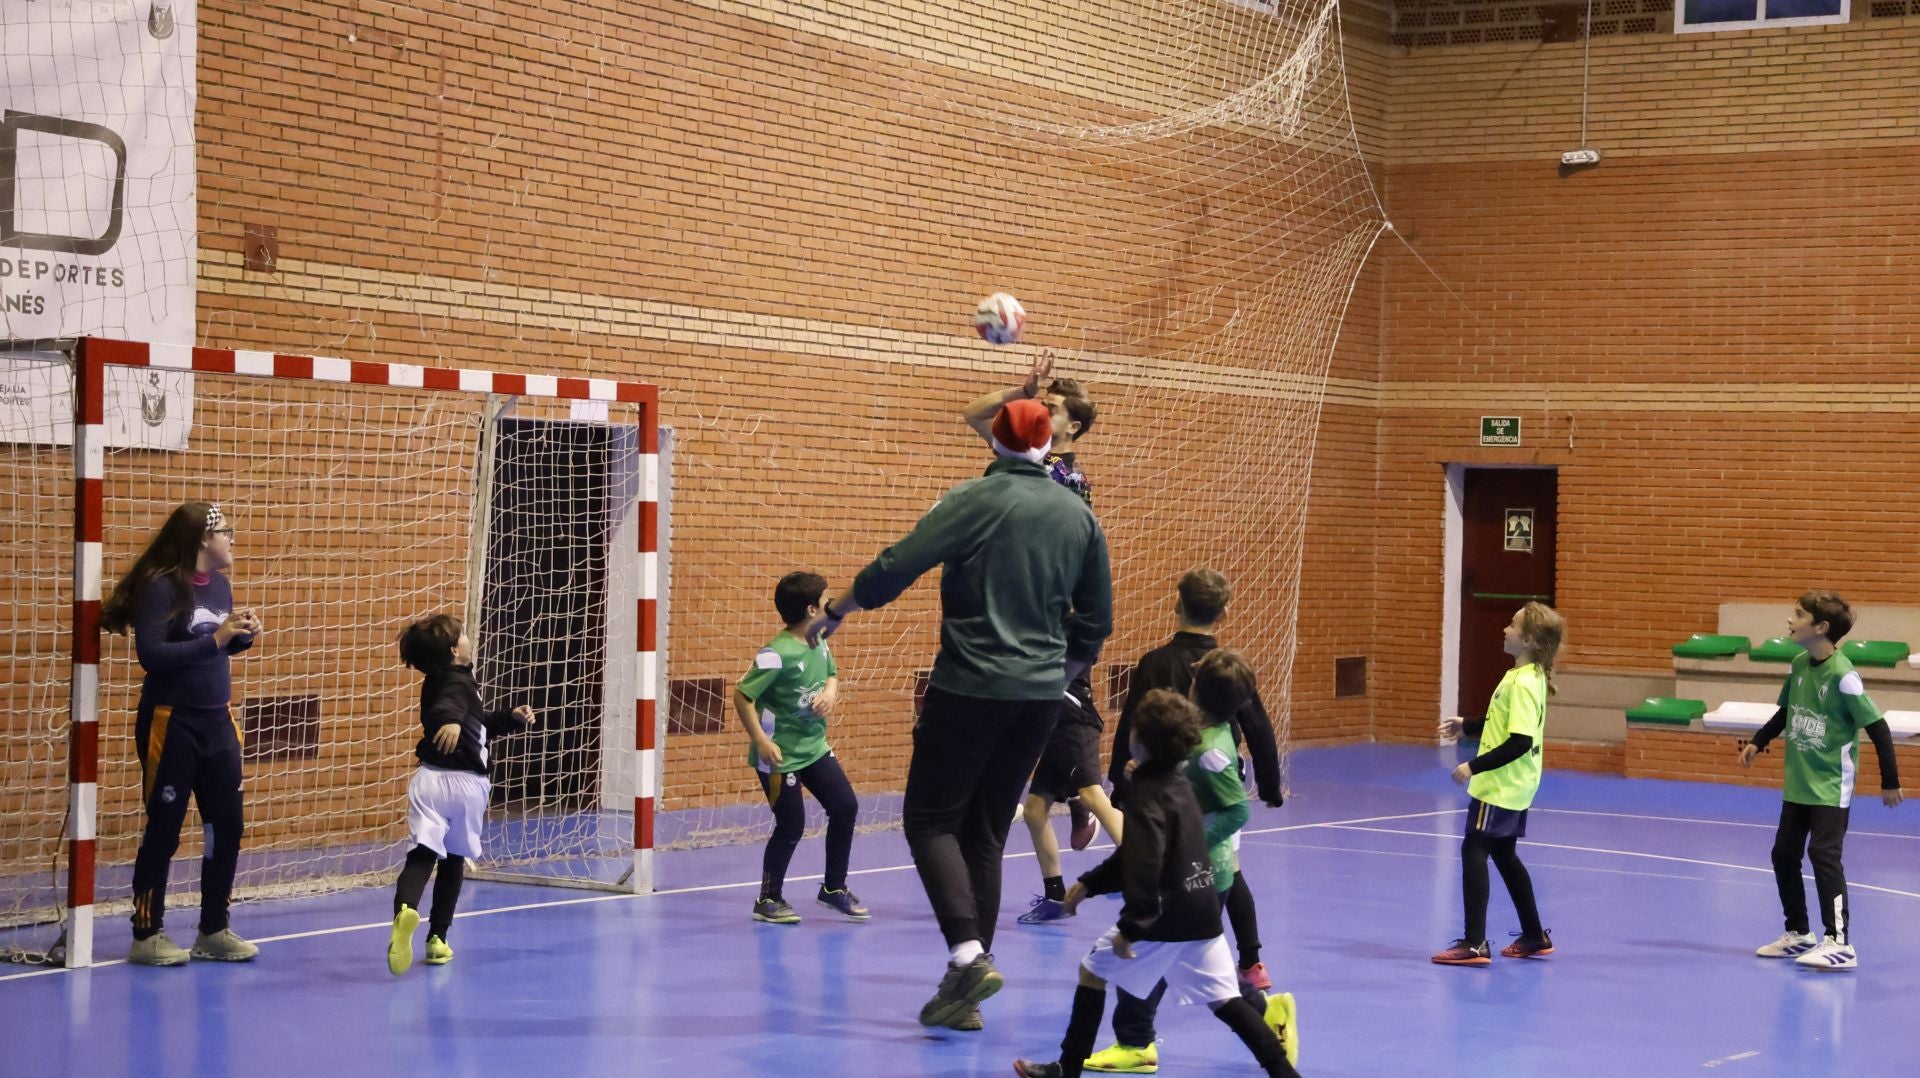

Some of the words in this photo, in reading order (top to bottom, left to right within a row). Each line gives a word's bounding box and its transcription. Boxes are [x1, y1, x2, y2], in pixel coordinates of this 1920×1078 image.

[0, 258, 124, 287] DEPORTES
[1491, 419, 1511, 427] SALIDA
[1496, 427, 1505, 435] DE
[1482, 435, 1518, 443] EMERGENCIA
